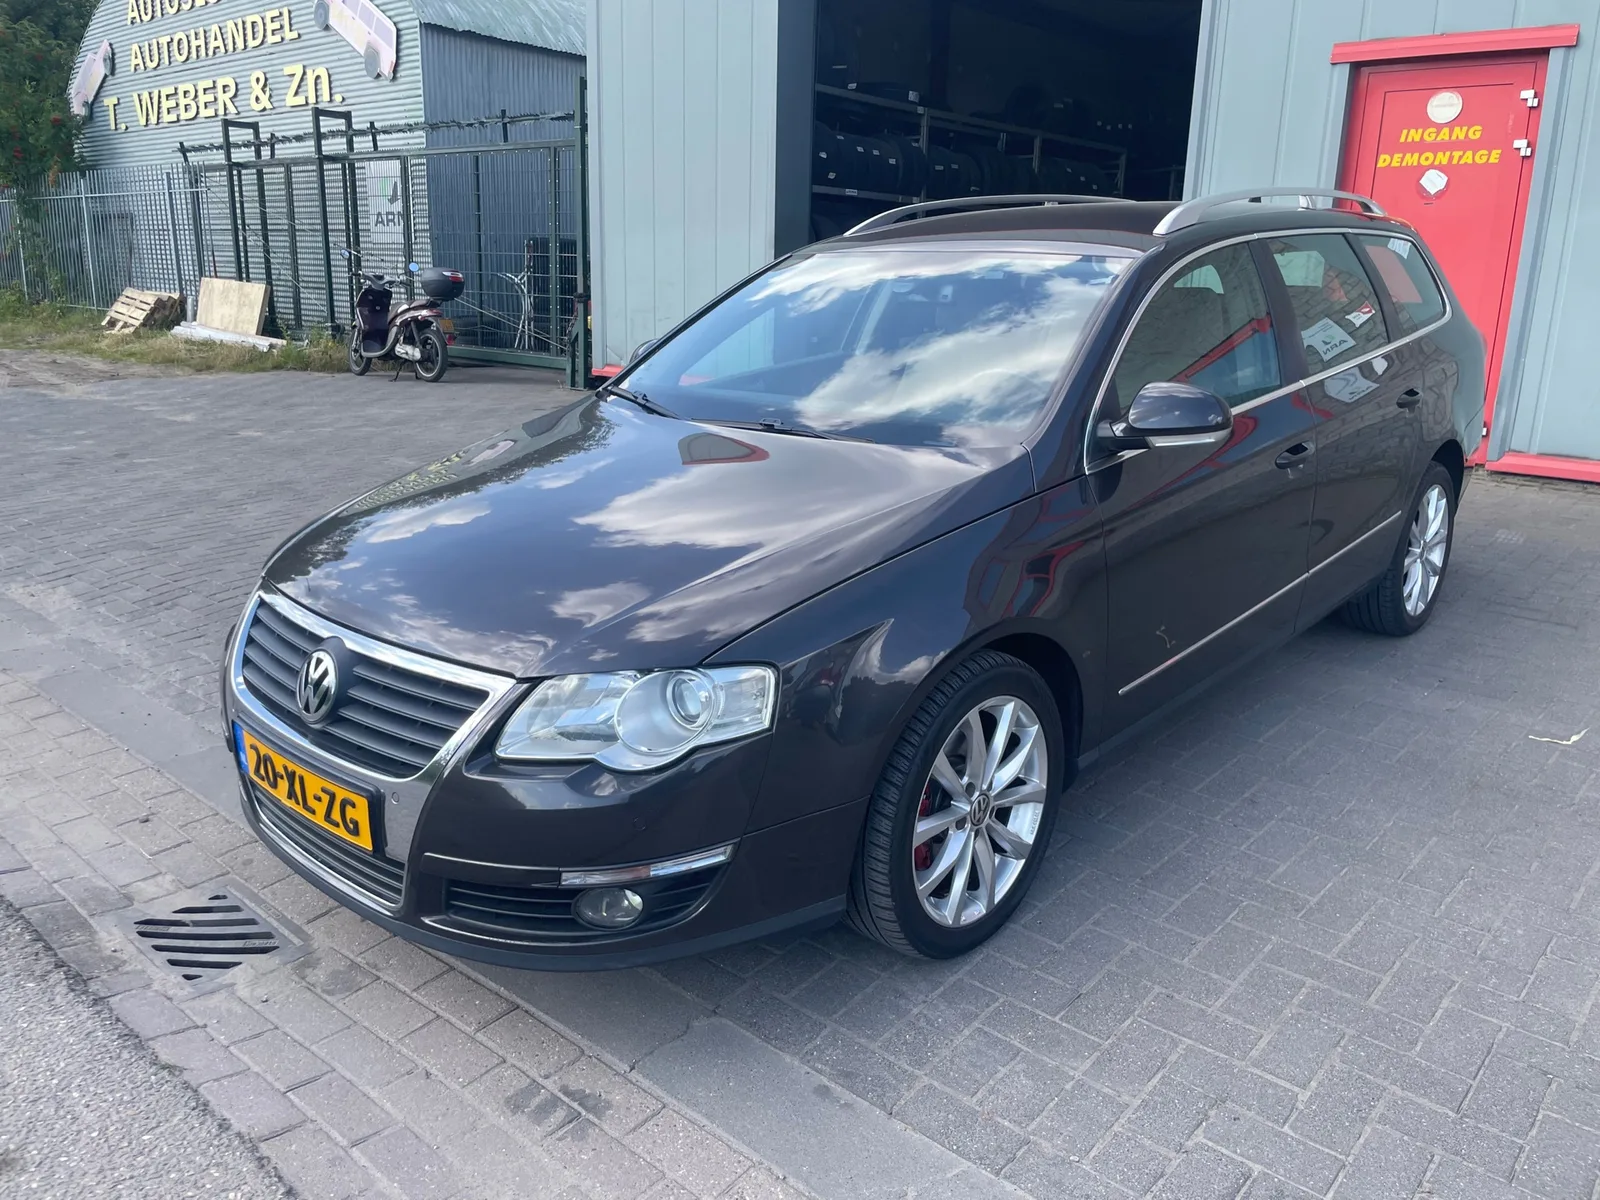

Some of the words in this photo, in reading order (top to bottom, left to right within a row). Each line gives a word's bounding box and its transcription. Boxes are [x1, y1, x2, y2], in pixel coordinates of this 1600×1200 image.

[127, 0, 217, 25] AUTO
[130, 7, 299, 72] AUTOHANDEL
[104, 96, 128, 130] T.
[132, 76, 238, 126] WEBER
[249, 70, 273, 112] &
[283, 63, 344, 107] Zn.
[1400, 125, 1482, 142] INGANG
[1377, 149, 1501, 167] DEMONTAGE
[249, 743, 360, 836] 20-XL-ZG
